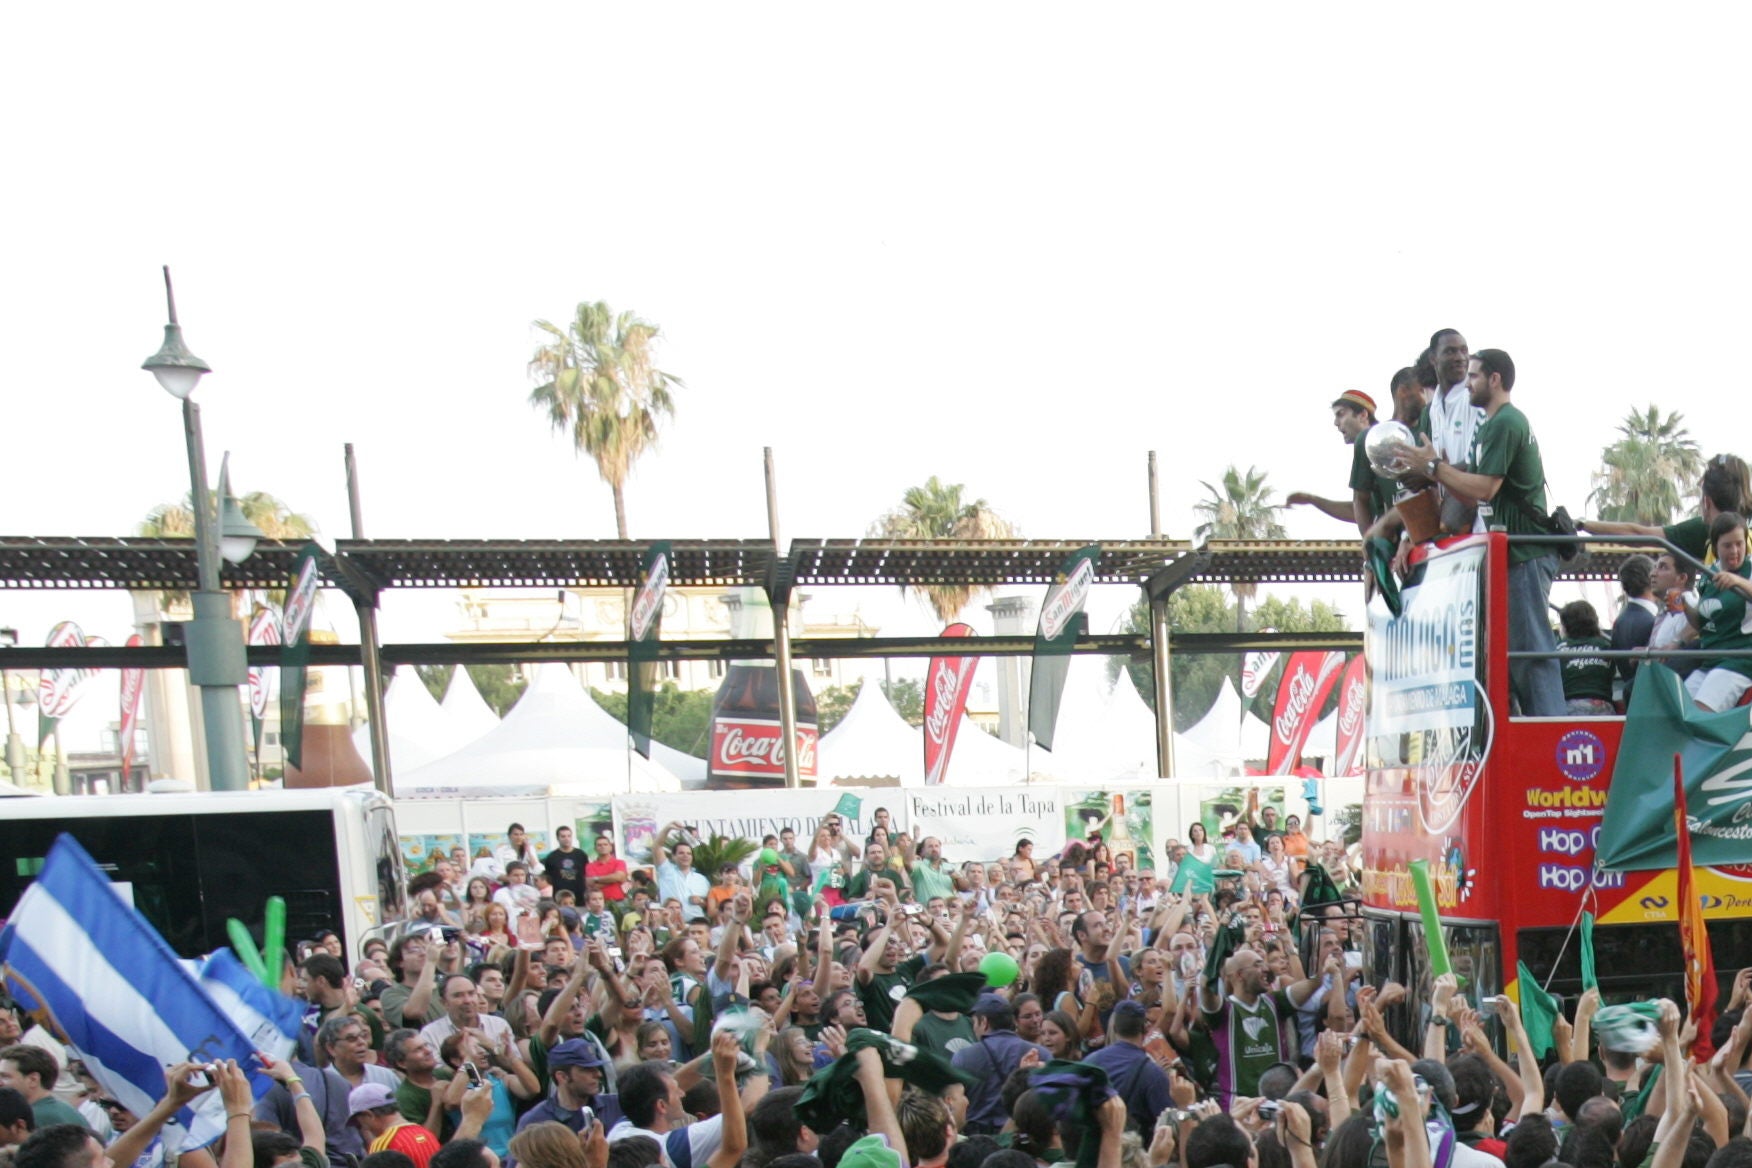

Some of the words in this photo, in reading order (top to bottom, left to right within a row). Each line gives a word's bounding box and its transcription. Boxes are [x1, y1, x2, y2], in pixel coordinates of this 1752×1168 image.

[913, 796, 971, 818] Festival
[976, 795, 994, 815] de
[1000, 795, 1013, 815] la
[1018, 793, 1056, 819] Tapa
[1541, 829, 1585, 855] Hop
[1541, 866, 1585, 891] Hop
